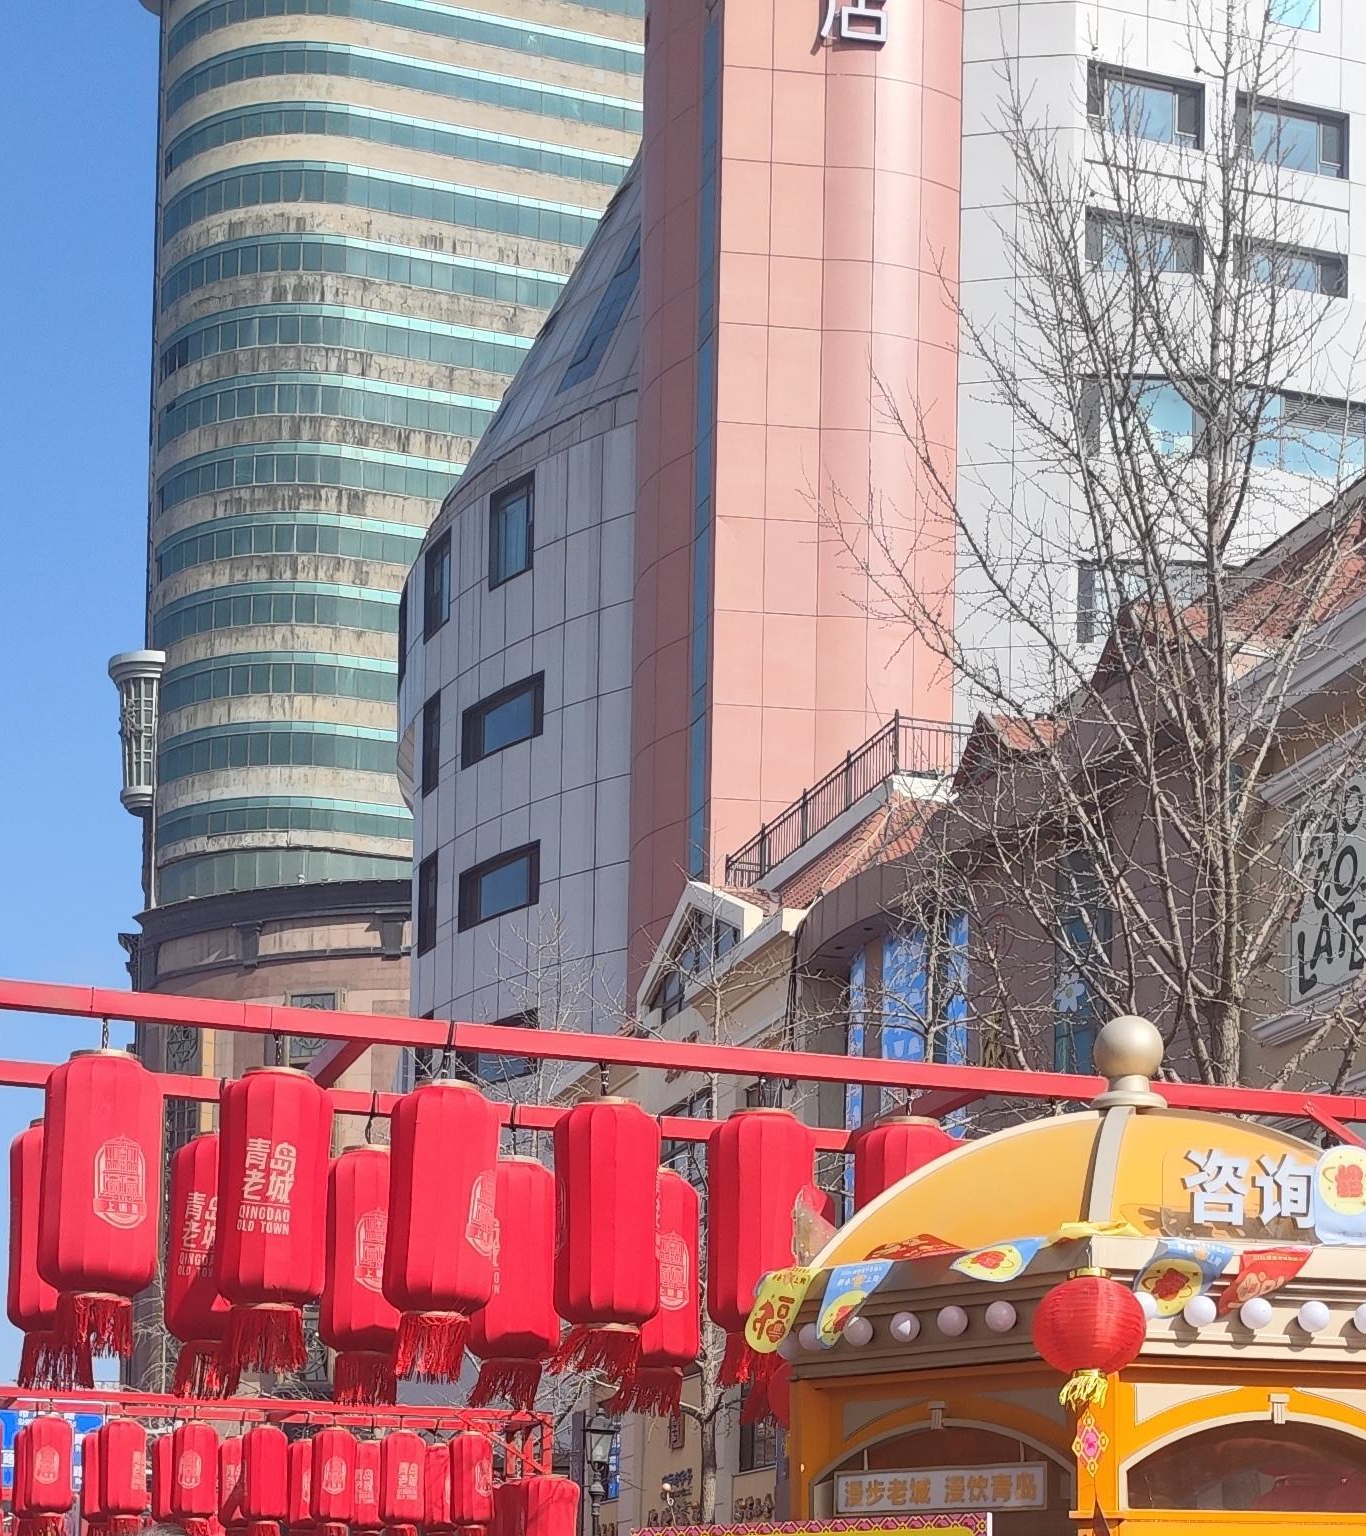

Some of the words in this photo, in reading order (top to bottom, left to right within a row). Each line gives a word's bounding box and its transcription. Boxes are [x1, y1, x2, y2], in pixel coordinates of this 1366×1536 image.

[244, 1137, 297, 1171] 青岛
[241, 1170, 293, 1202] 老城
[1182, 1149, 1330, 1229] 咨询
[237, 1221, 254, 1232] OLD
[261, 1222, 289, 1235] TOWN
[239, 1205, 290, 1223] QINGDAO
[844, 1477, 931, 1507] 漫步老城
